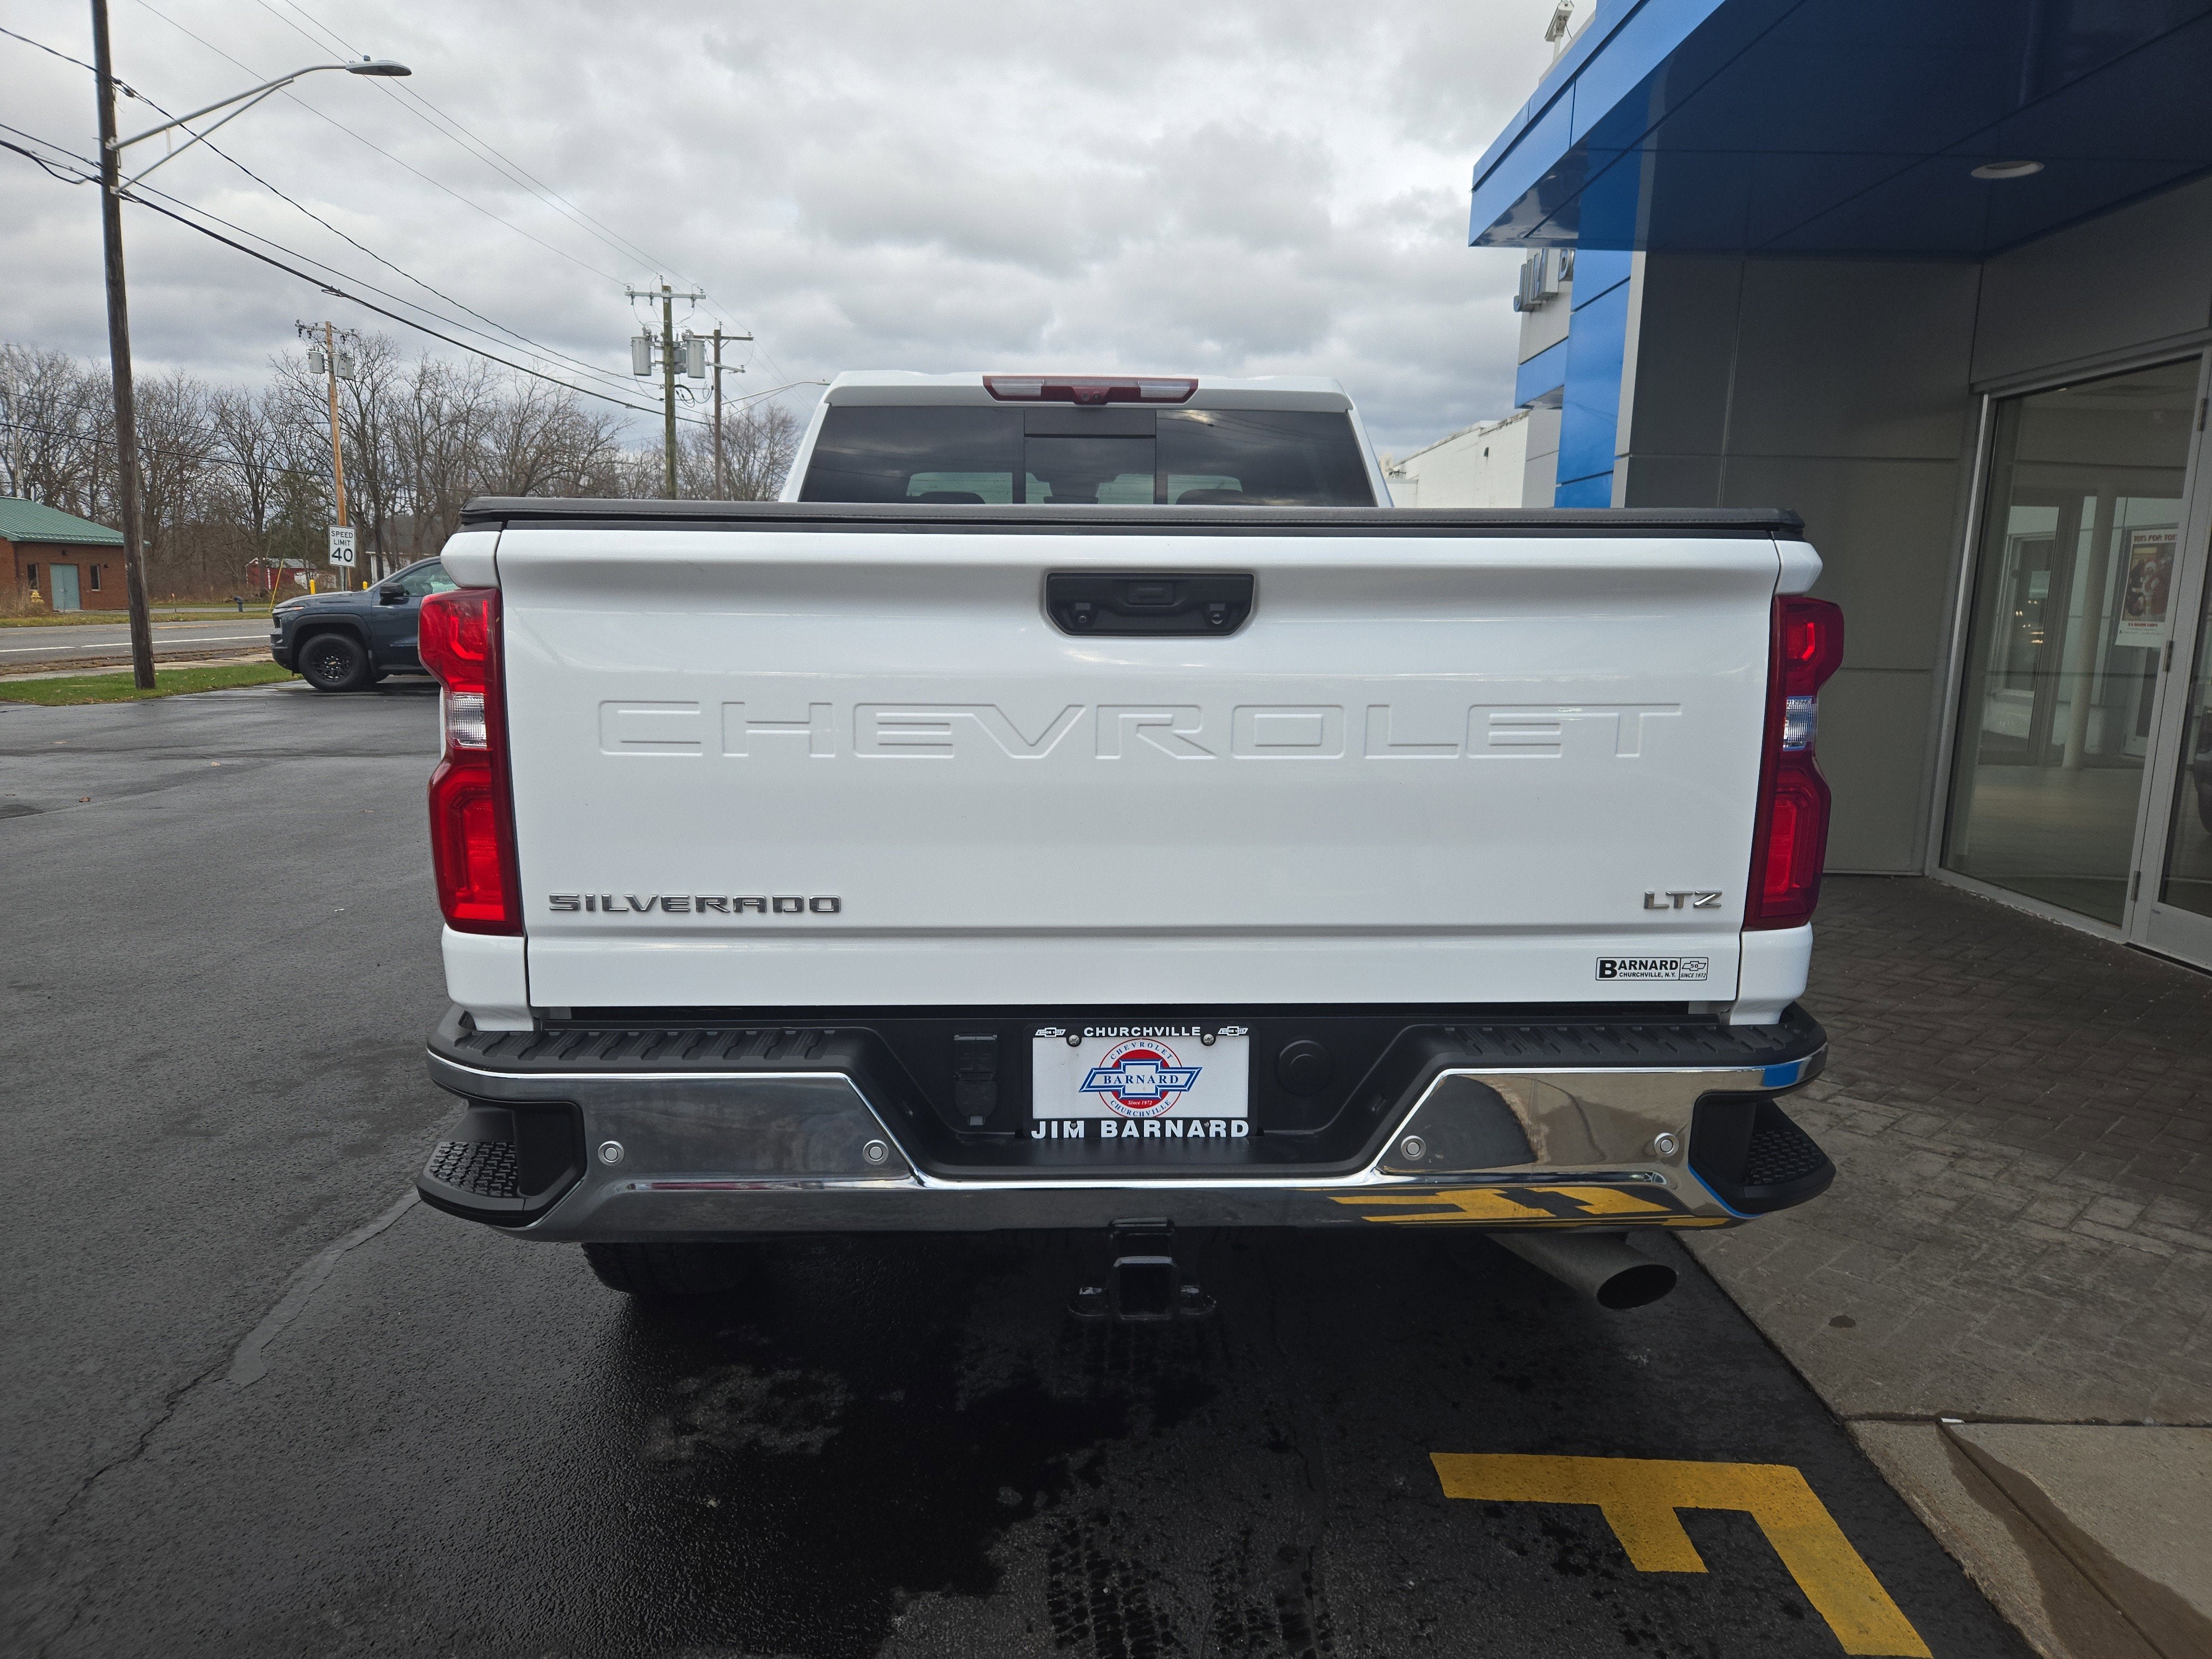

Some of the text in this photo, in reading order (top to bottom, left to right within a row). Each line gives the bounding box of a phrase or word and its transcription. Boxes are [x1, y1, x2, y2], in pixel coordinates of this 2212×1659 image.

[331, 547, 353, 563] 40
[598, 700, 1682, 759] CHEVROLET
[549, 893, 842, 913] SILVERADO
[1644, 890, 1722, 909] LTZ
[1599, 960, 1679, 978] BARNARD
[1084, 1026, 1201, 1037] CHURCHVILLE
[1110, 1041, 1173, 1060] CHEVROLET
[1103, 1075, 1179, 1084] BARNARD
[1110, 1099, 1171, 1117] CHURCHVILLE
[1031, 1120, 1249, 1139] JIM BARNARD
